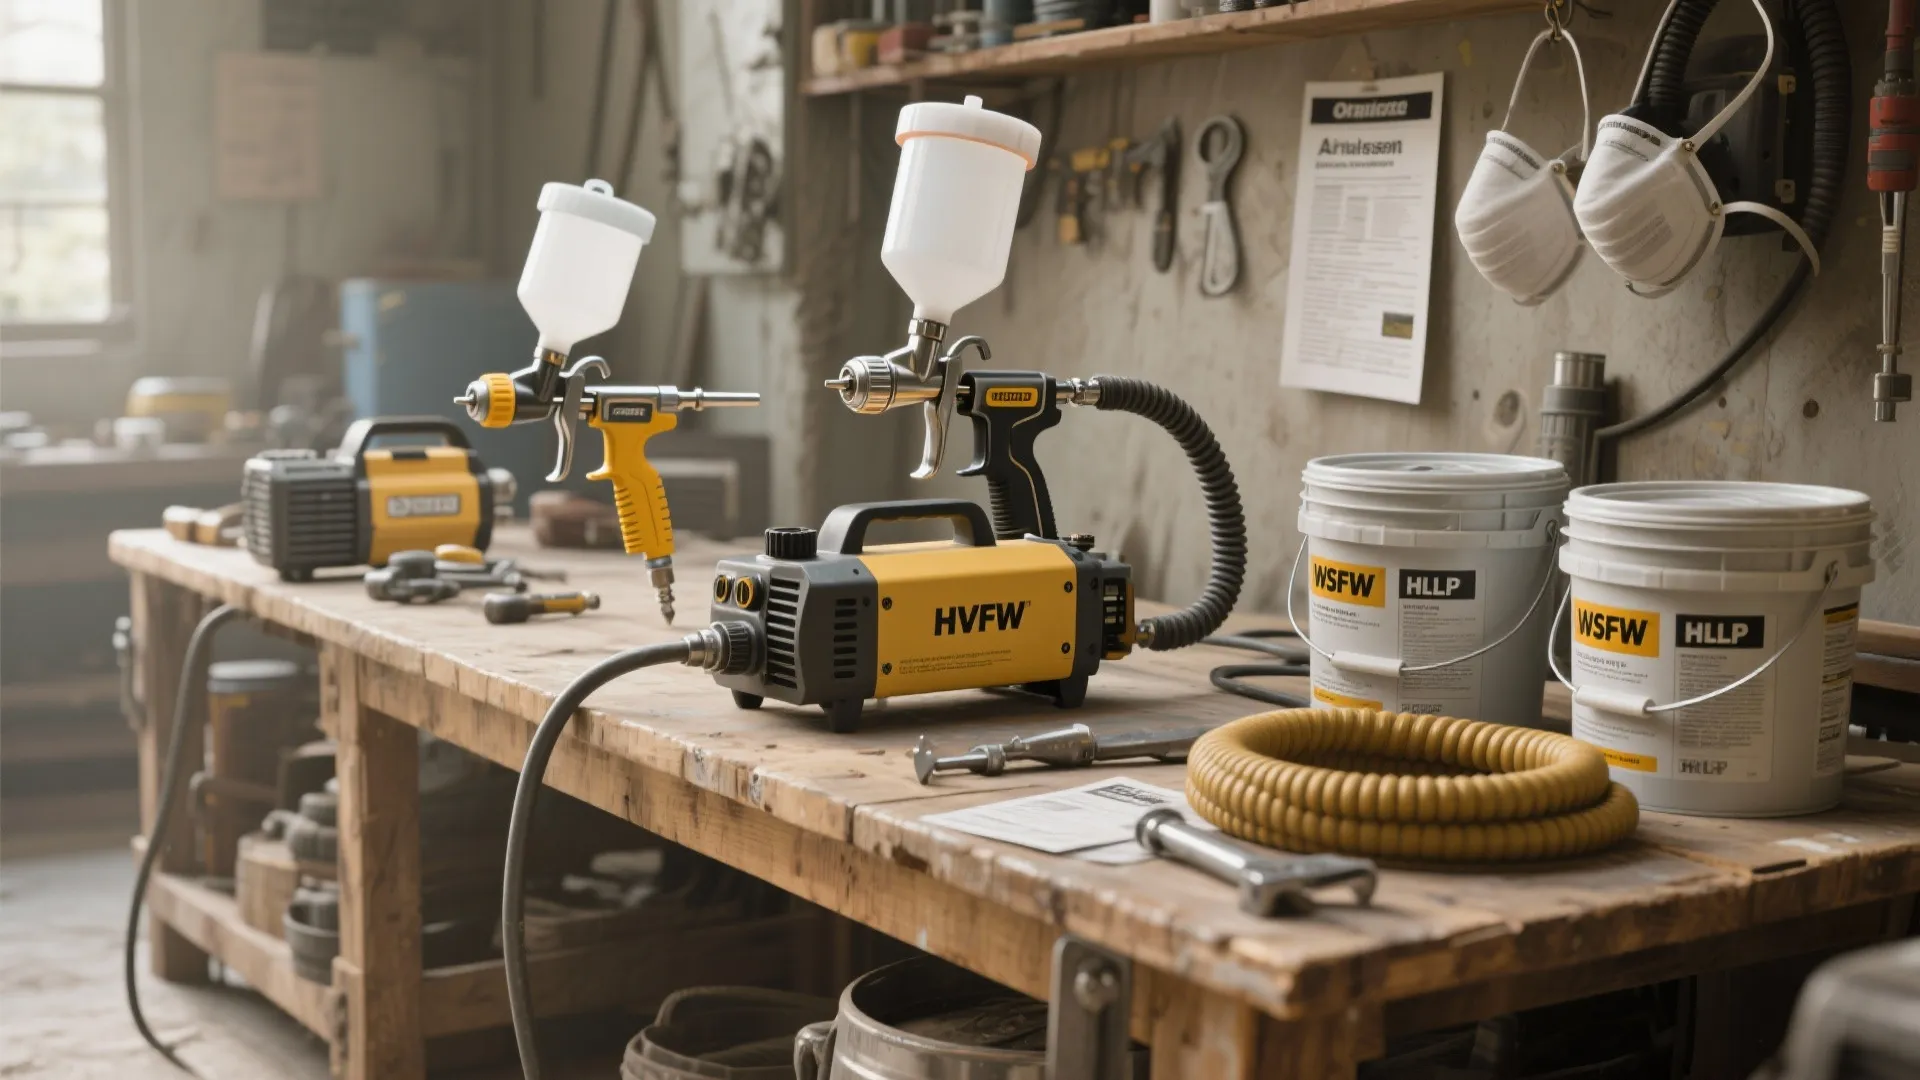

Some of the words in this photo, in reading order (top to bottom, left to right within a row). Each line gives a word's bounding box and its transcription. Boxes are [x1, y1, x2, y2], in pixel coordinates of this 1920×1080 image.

[1314, 564, 1376, 598] WSFW
[1406, 576, 1461, 596] HLLP
[1577, 608, 1648, 646] WSFW
[1684, 622, 1749, 645] HLLP
